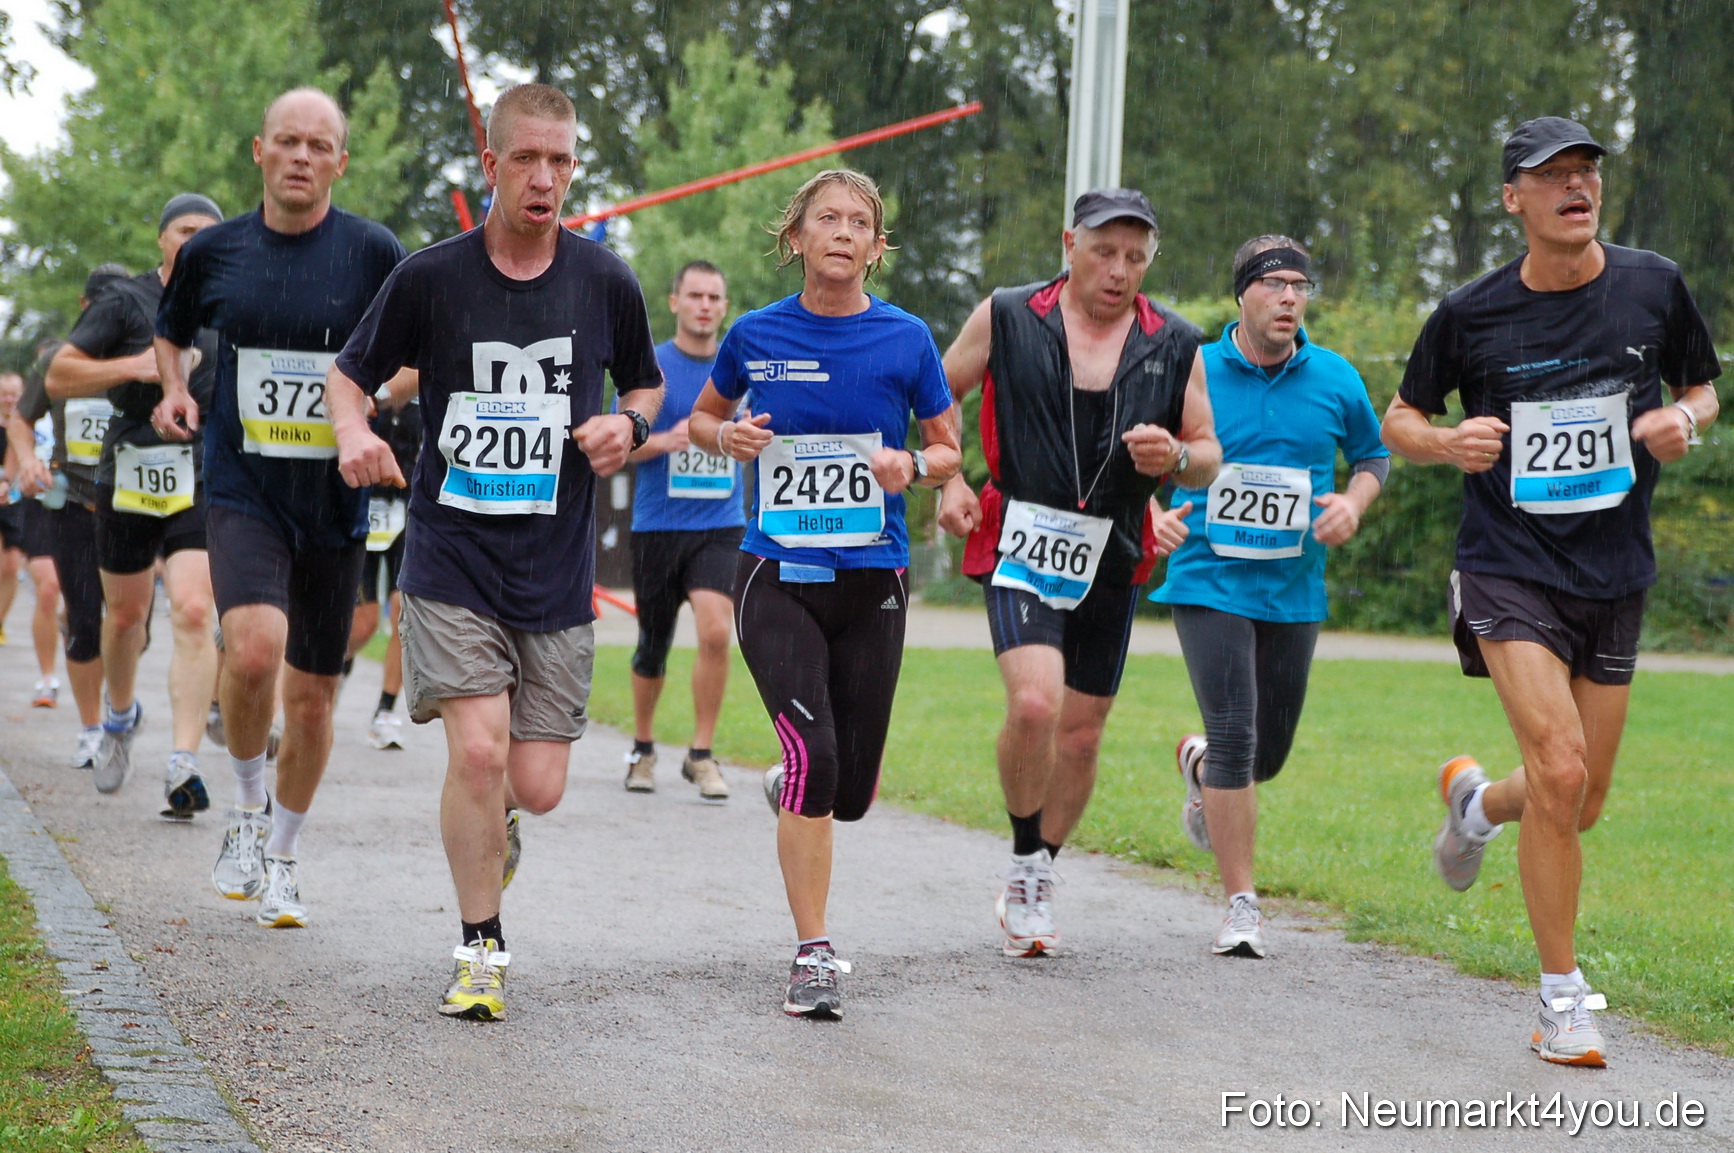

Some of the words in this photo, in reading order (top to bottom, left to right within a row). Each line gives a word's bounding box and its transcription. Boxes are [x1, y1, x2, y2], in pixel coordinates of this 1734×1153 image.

[257, 379, 327, 418] 372
[476, 400, 527, 414] BOCK
[269, 425, 312, 443] Heiko
[449, 424, 553, 470] 2204
[795, 440, 844, 455] BOCK
[1526, 425, 1616, 473] 2291
[678, 451, 728, 474] 3294
[133, 465, 177, 493] 196
[466, 476, 537, 498] Christian
[772, 463, 871, 506] 2426
[1547, 480, 1601, 498] Werner
[1217, 487, 1300, 526] 2267
[797, 514, 844, 533] Helga
[1234, 530, 1278, 548] Martin
[1009, 530, 1092, 576] 2466
